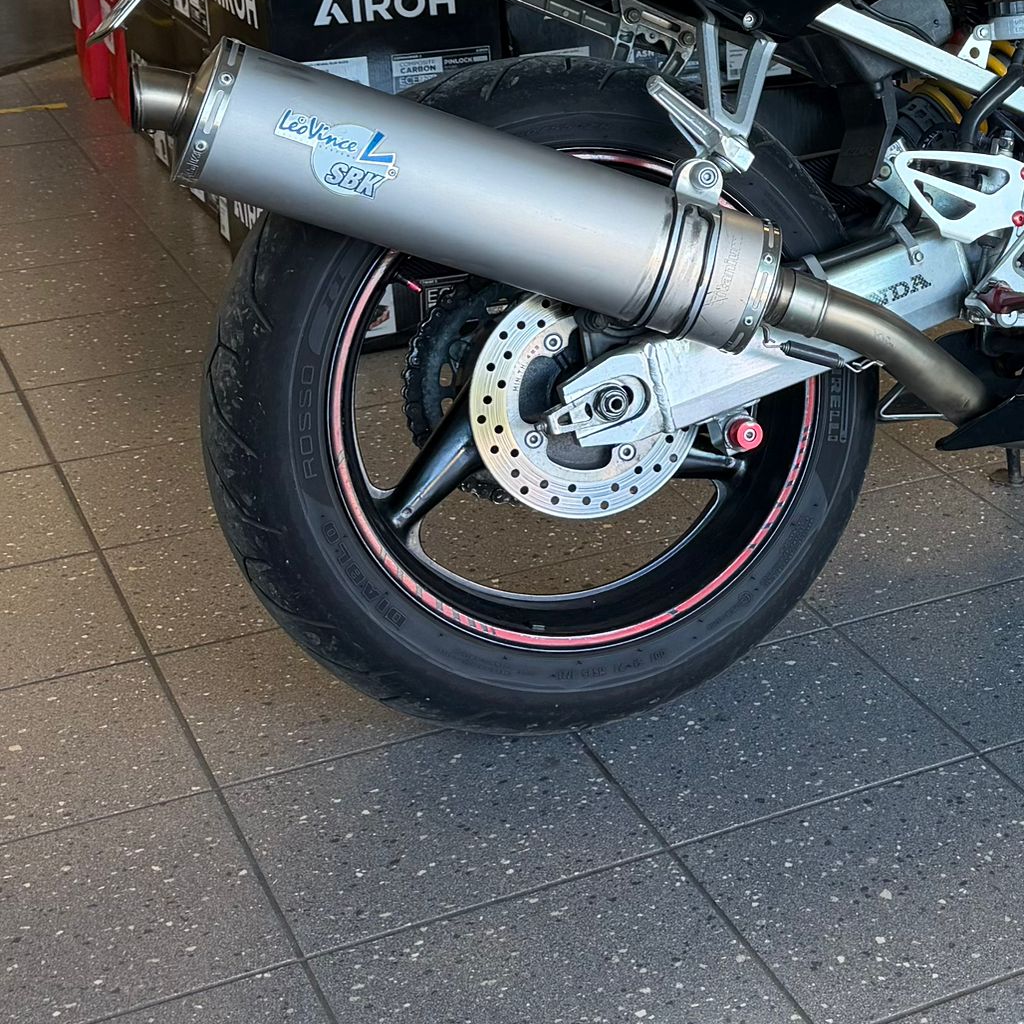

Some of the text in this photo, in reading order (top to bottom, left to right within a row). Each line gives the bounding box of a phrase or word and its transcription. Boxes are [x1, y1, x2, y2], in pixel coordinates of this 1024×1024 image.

[400, 65, 437, 74] CARBON
[324, 162, 387, 197] SBK
[297, 364, 318, 480] ROSSO
[827, 368, 842, 443] IRELLI
[321, 521, 408, 630] DIABLO
